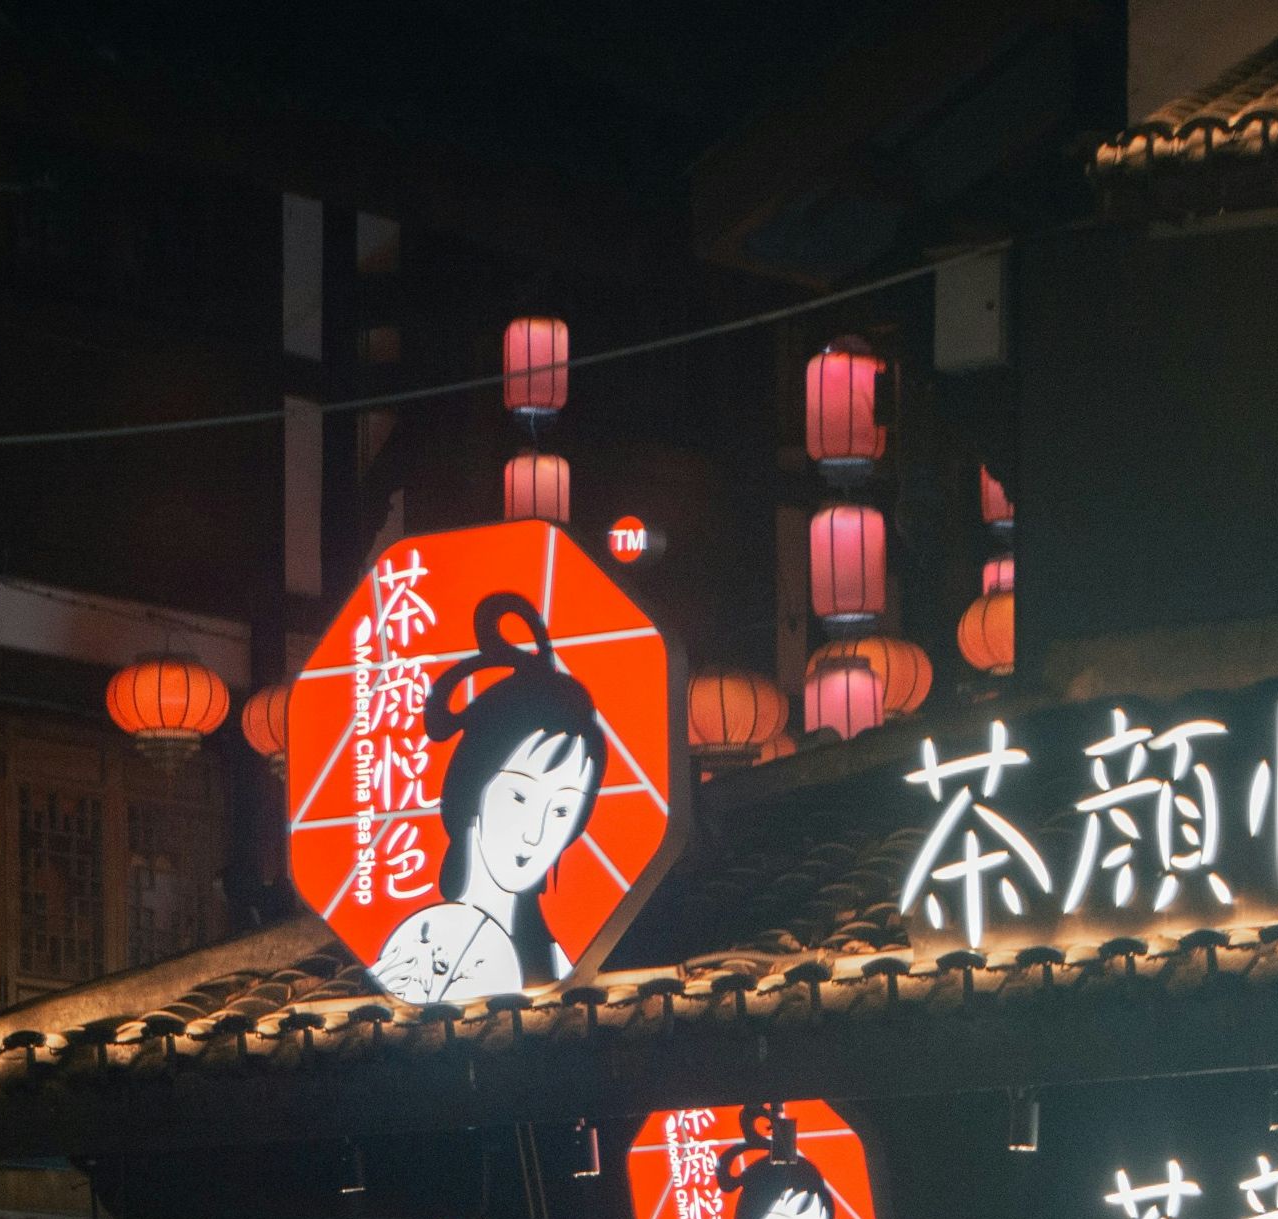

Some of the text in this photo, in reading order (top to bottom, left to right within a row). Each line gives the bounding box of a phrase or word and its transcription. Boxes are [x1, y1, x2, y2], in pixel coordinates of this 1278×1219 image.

[611, 530, 646, 550] TM
[354, 647, 376, 905] Modern China Tea Shop
[667, 1132, 683, 1188] Modern
